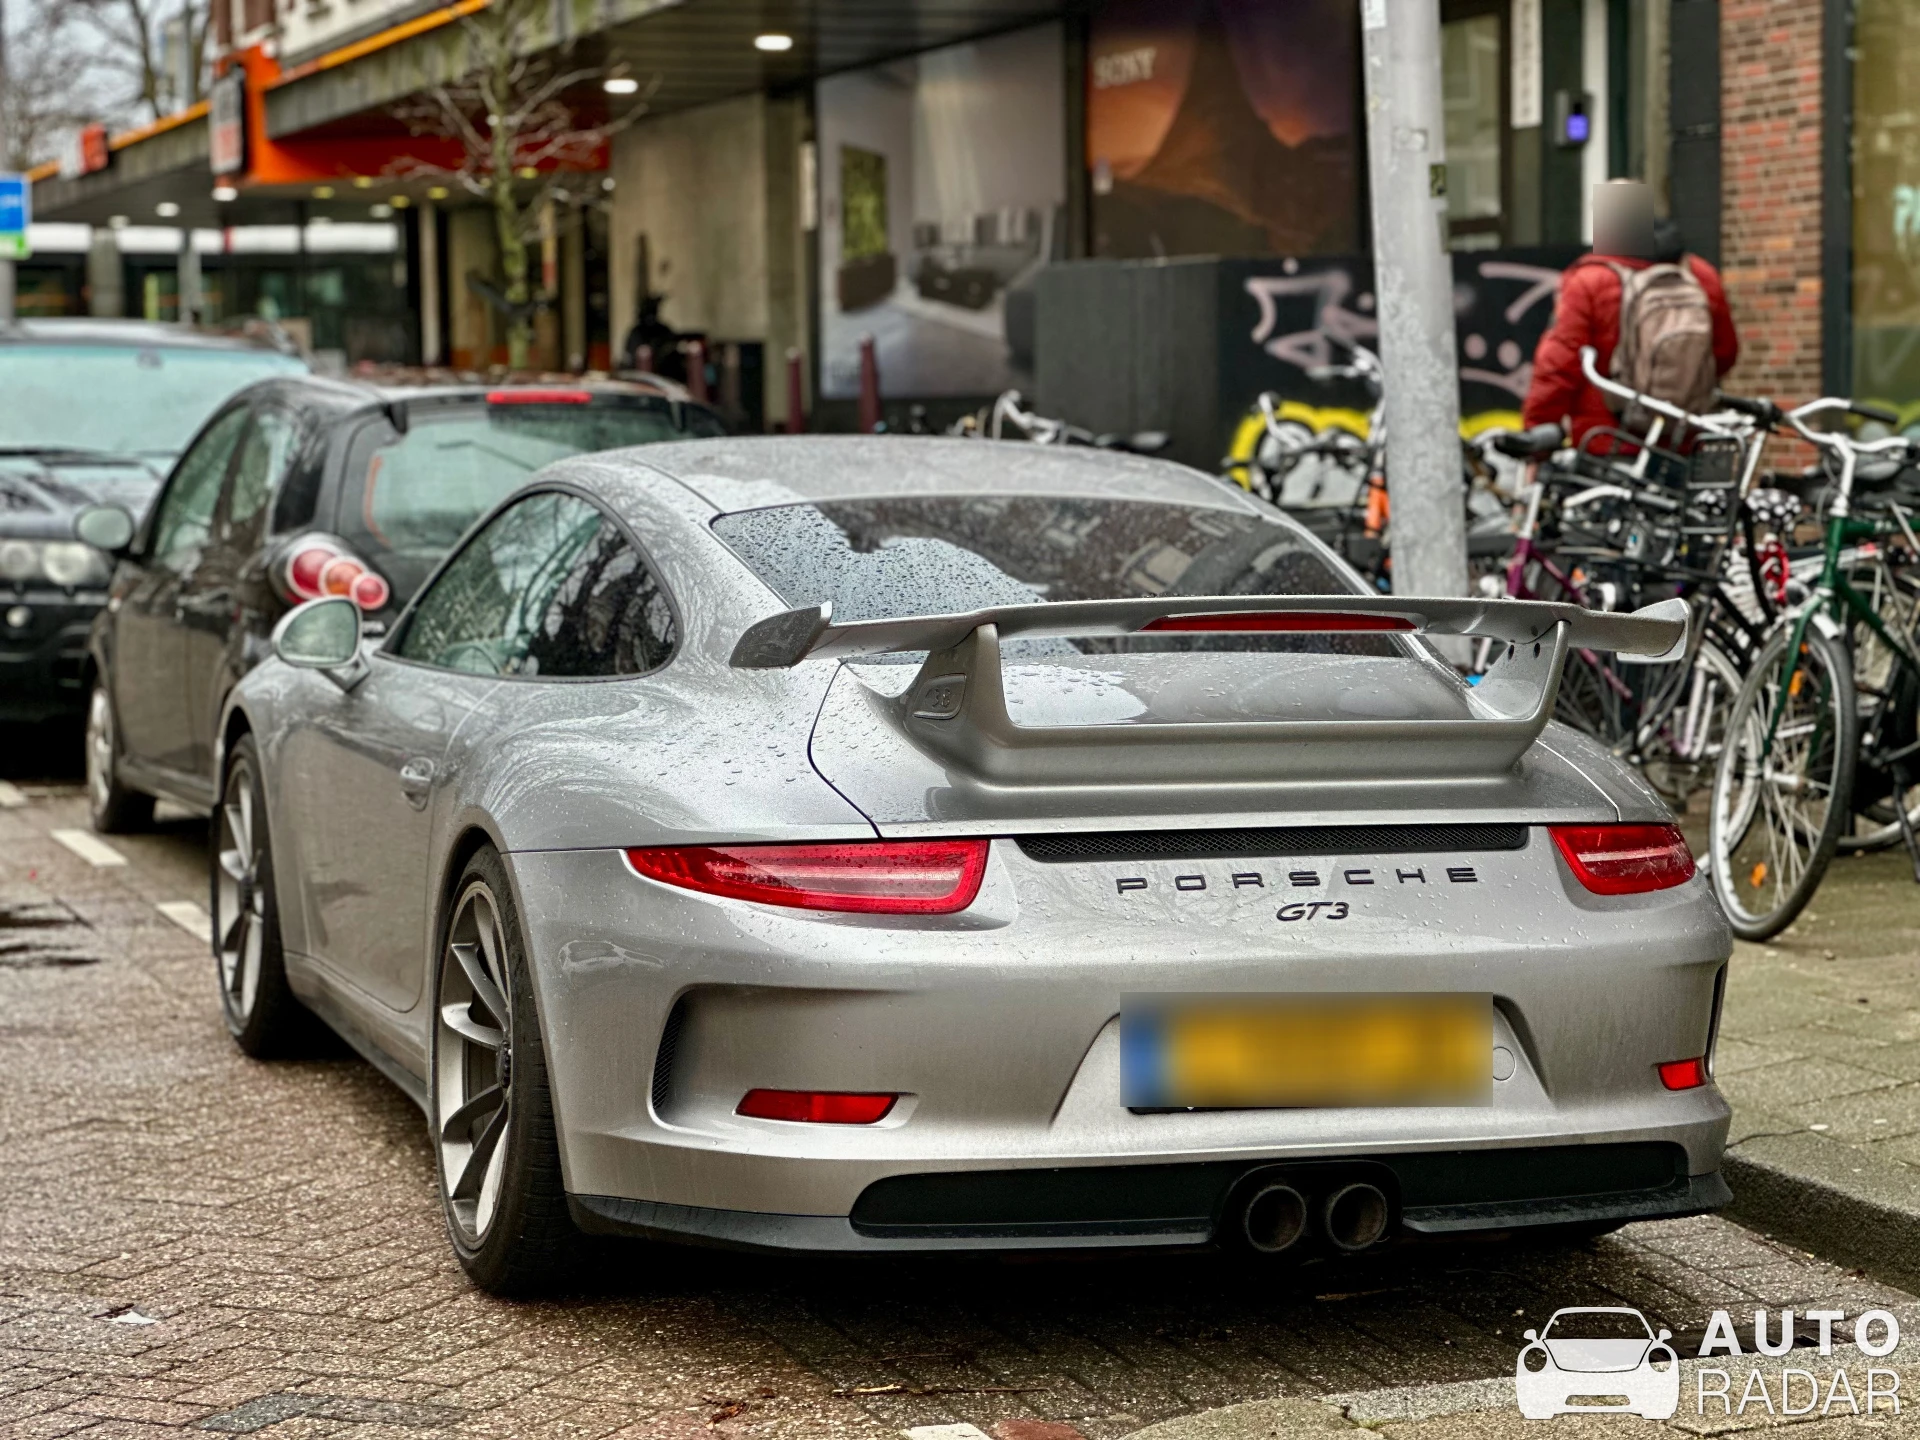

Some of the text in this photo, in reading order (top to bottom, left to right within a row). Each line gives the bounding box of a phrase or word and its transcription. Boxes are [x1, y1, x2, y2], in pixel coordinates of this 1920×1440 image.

[1093, 47, 1157, 89] SONY
[1116, 867, 1479, 894] PORSCHE
[1276, 901, 1350, 922] GT3
